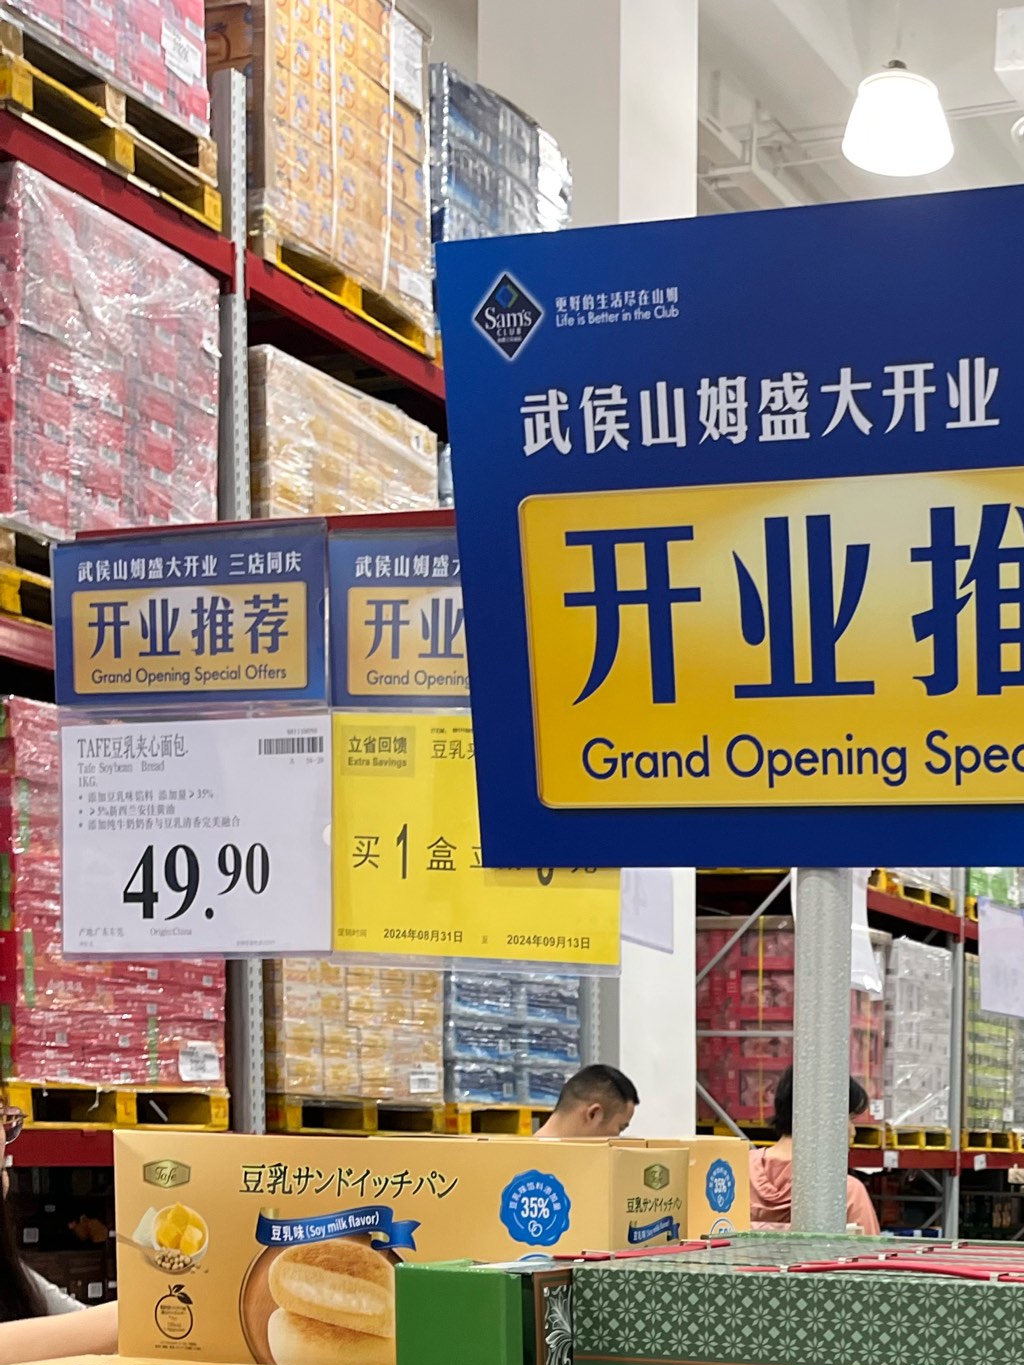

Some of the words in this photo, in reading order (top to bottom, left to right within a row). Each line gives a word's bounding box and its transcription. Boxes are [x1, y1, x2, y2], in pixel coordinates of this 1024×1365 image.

[555, 287, 679, 312] 更好的生活尽在山姆
[485, 307, 532, 330] Sam's
[556, 313, 575, 327] Life
[577, 313, 586, 325] is
[588, 309, 620, 325] Better
[622, 309, 632, 321] in
[634, 307, 651, 320] the
[654, 305, 679, 319] Club
[522, 357, 1000, 457] 武侯山姆盛大开业
[77, 559, 218, 584] 武侯山姆盛大开业
[229, 551, 302, 576] 三店同庆
[87, 594, 290, 660] 开业推荐
[91, 667, 133, 685] Grand
[135, 665, 192, 687] Opening
[194, 664, 241, 684] Special
[245, 664, 287, 681] Offers
[366, 669, 410, 686] Grand
[348, 735, 408, 755] 立省回馈
[99, 761, 132, 775] Soybean
[141, 760, 165, 773] Bread
[348, 757, 370, 767] Extra
[373, 757, 407, 768] Savings
[582, 737, 711, 782] Grand
[721, 731, 908, 789] Opening
[352, 836, 380, 869] 买
[396, 823, 408, 880] 1
[427, 836, 457, 871] 盒
[123, 843, 270, 921] 49.90
[384, 928, 463, 943] 2024年08月31日
[507, 934, 590, 950] 2024年09月13日
[239, 1161, 458, 1201] 豆乳サンドイッチパン
[520, 1198, 549, 1219] 35%
[271, 1224, 304, 1242] 豆乳味
[306, 1223, 326, 1239] (Soy
[327, 1218, 348, 1233] milk
[348, 1211, 380, 1228] flavor)
